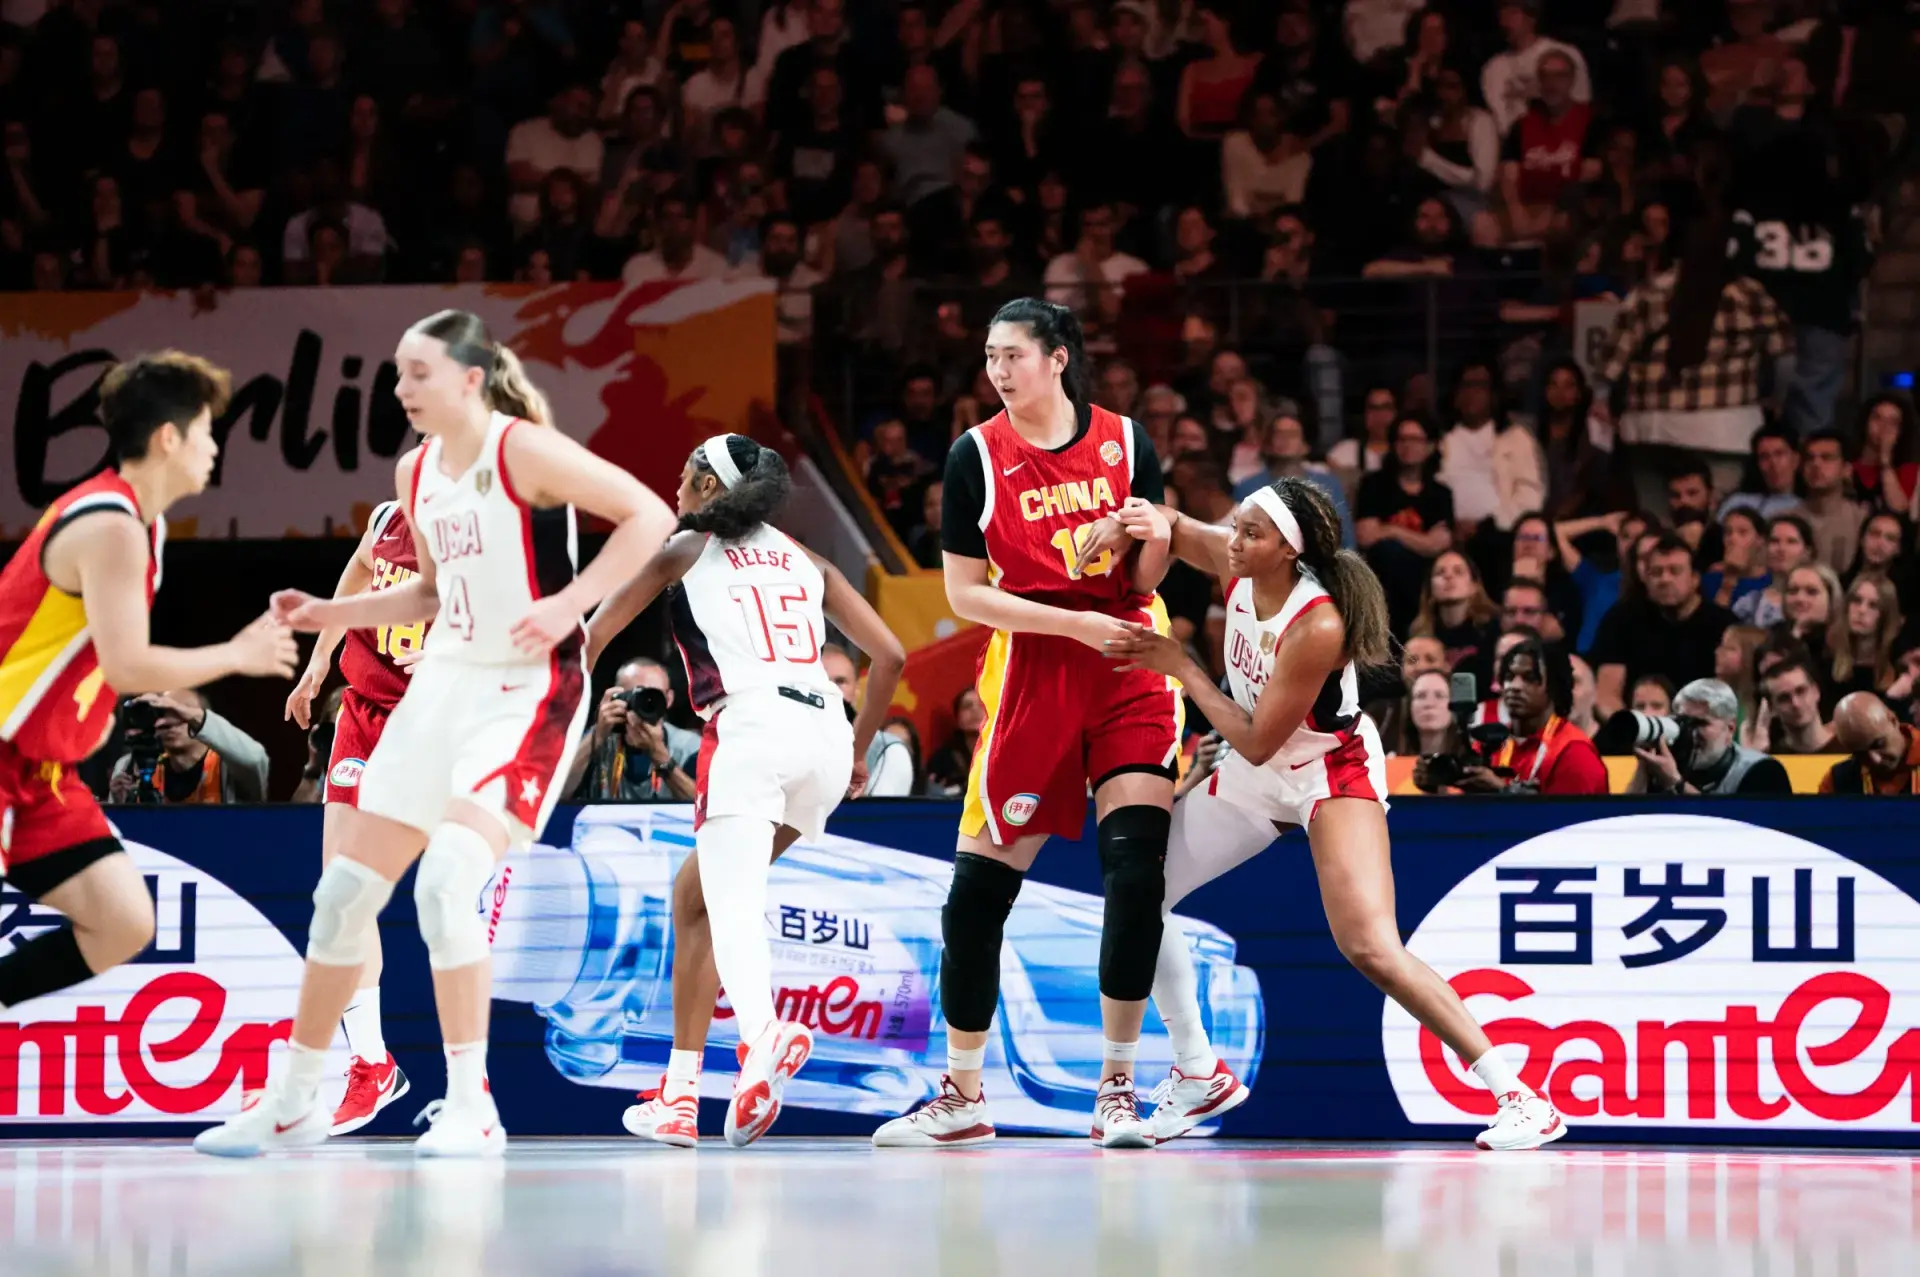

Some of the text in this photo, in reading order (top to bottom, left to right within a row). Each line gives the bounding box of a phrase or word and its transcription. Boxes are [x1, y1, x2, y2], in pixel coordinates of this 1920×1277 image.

[14, 329, 424, 508] Brli
[1019, 477, 1116, 522] CHINA
[433, 509, 483, 563] USA
[724, 547, 793, 572] REESE
[446, 574, 475, 642] 4
[728, 583, 818, 664] 15
[1230, 628, 1271, 686] USA
[779, 904, 869, 950] 百岁山
[1495, 863, 1855, 968] 百岁山
